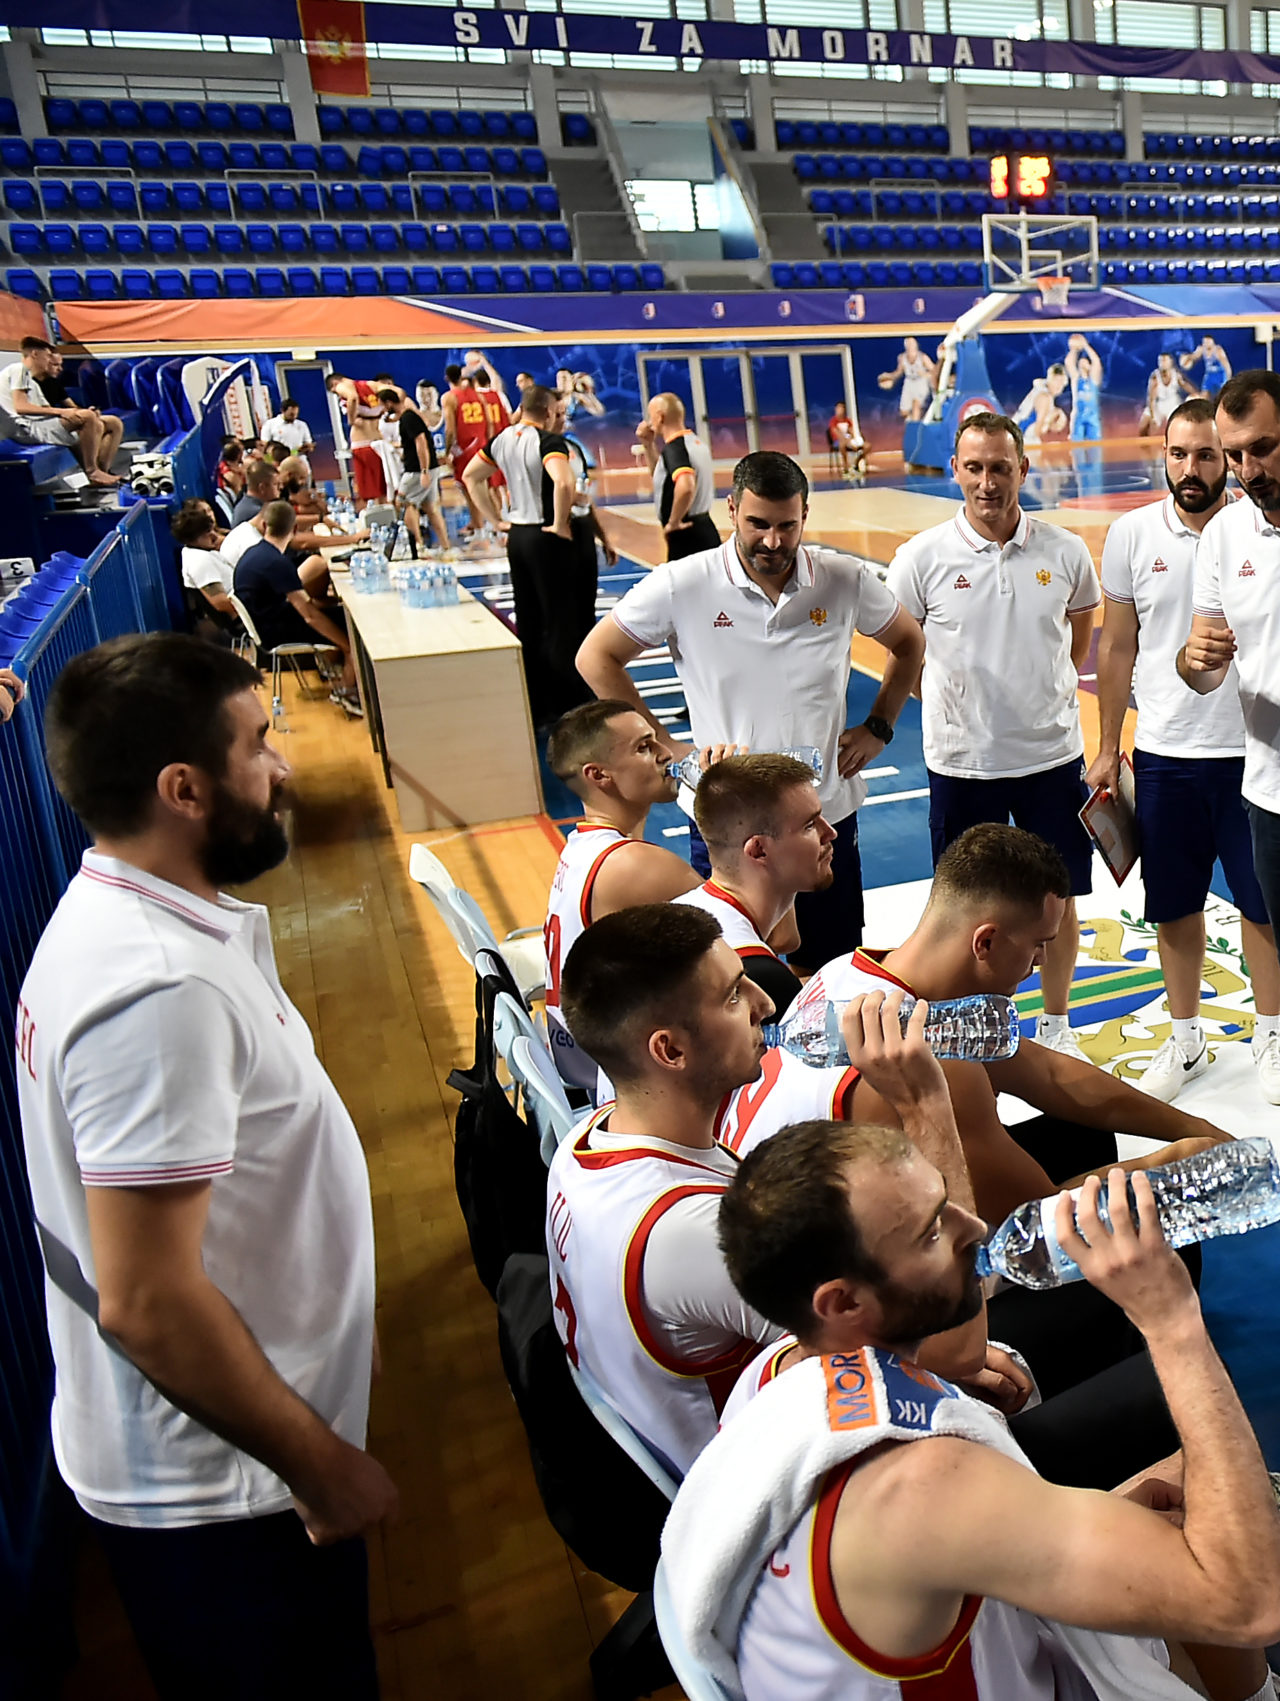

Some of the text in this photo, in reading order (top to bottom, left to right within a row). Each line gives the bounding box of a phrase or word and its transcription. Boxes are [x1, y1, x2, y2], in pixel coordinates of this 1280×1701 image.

[453, 11, 1014, 67] SVI ZA MORNAR
[461, 401, 483, 424] 22
[1238, 569, 1256, 577] PEAK
